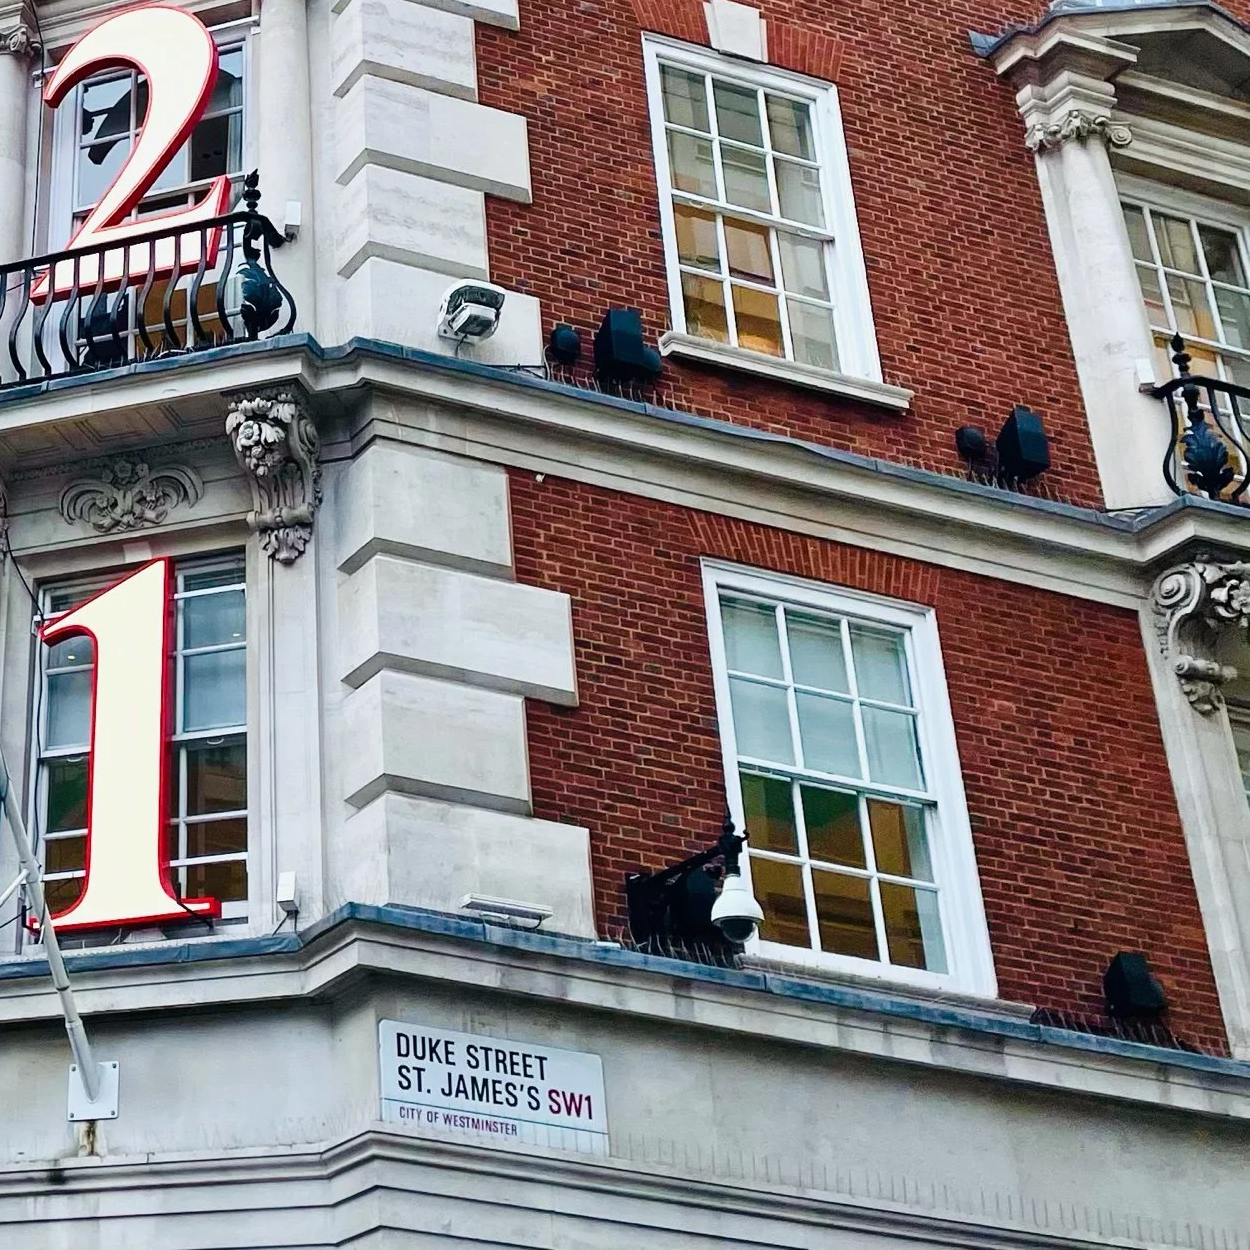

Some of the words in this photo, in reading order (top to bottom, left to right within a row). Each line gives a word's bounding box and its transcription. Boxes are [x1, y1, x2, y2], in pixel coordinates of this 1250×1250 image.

[396, 1032, 456, 1066] DUKE
[466, 1044, 548, 1081] STREET
[397, 1065, 431, 1095] ST.
[441, 1072, 541, 1111] JAMES'S
[548, 1088, 593, 1120] SW1
[399, 1106, 422, 1122] CITY
[427, 1111, 440, 1123] OF
[443, 1114, 518, 1136] WESTMINSTER
